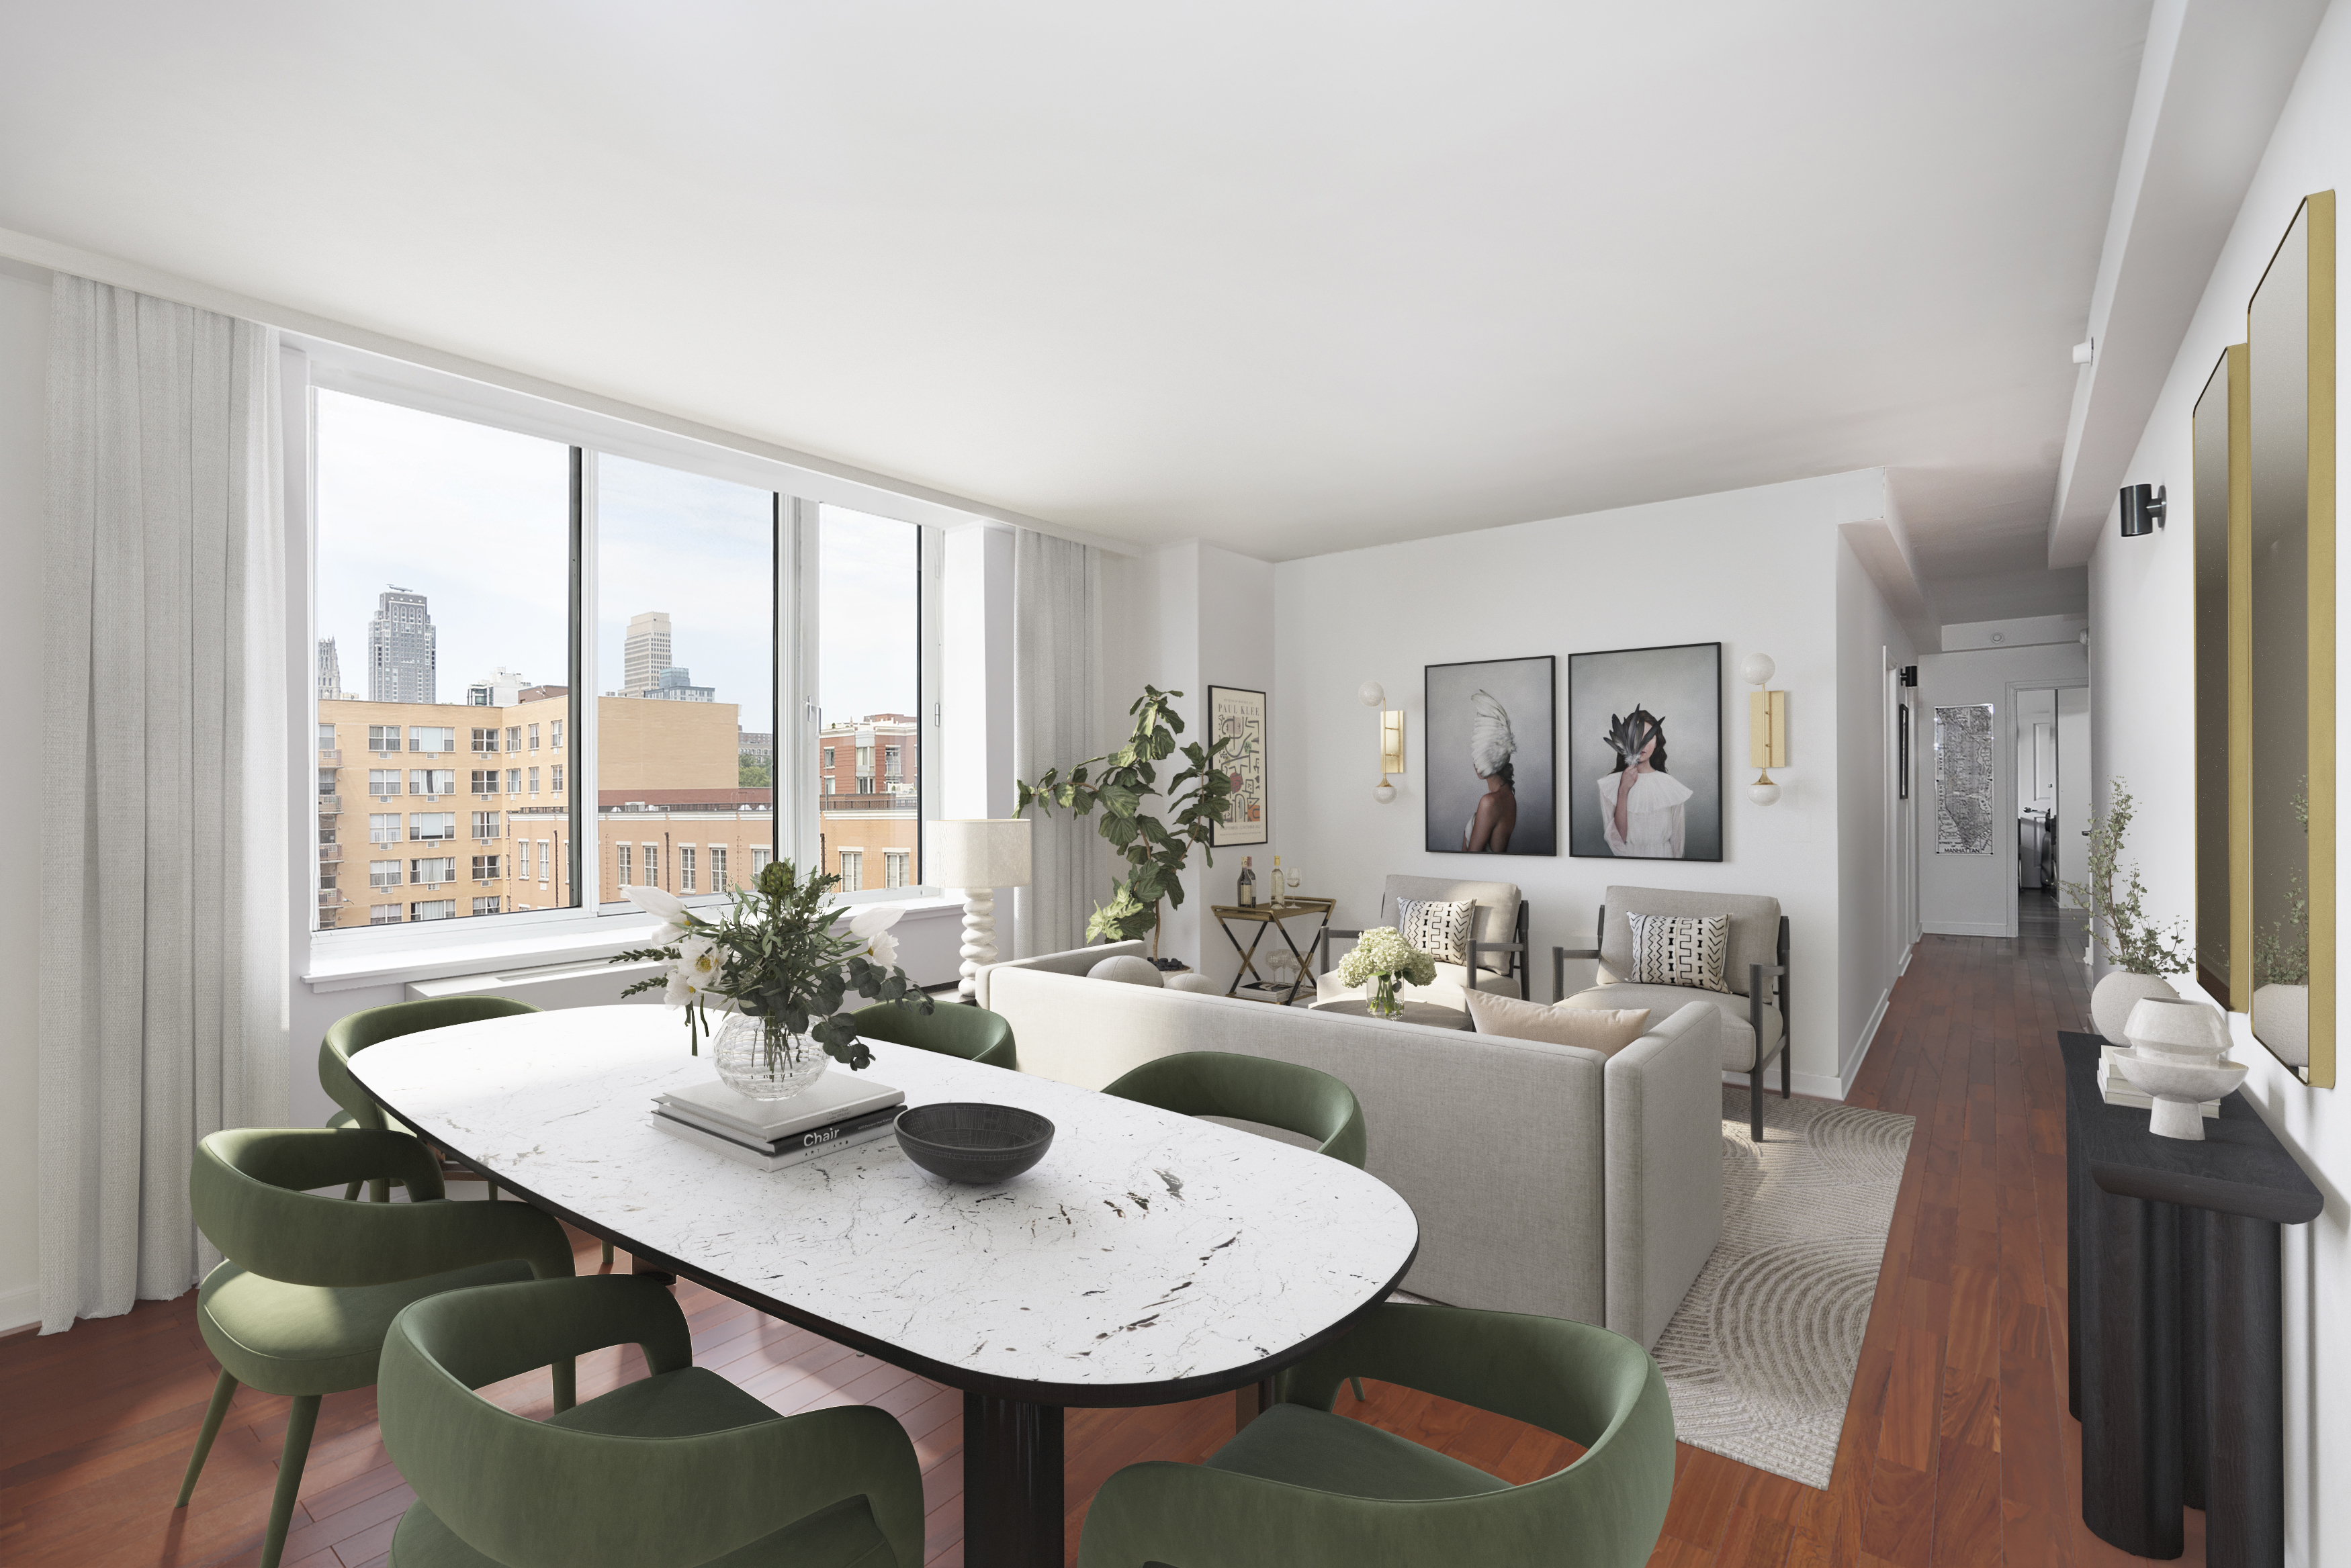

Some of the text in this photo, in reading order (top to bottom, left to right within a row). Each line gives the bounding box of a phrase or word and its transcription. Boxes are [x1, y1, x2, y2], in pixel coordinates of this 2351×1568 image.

[1218, 704, 1259, 716] PAUL KLEE
[803, 1127, 840, 1146] Chair
[805, 1148, 819, 1157] ART
